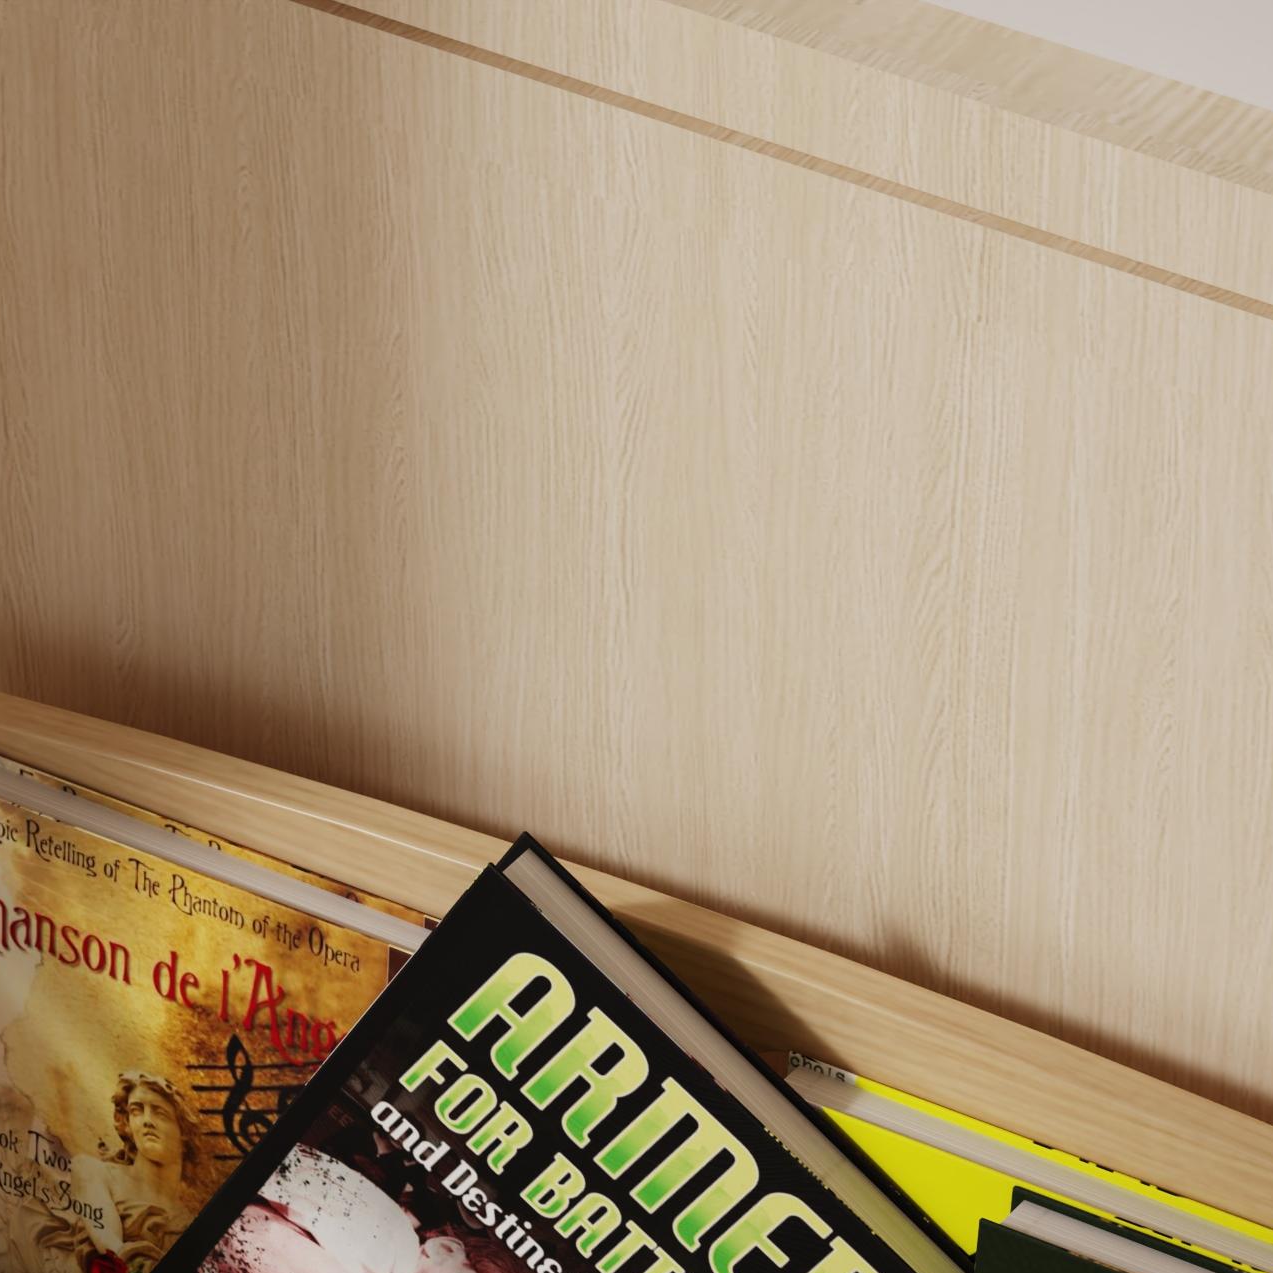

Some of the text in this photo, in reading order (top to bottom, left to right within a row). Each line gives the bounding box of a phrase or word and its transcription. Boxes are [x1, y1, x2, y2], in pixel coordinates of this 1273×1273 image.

[26, 819, 96, 879] Retelling
[104, 855, 121, 881] of
[129, 858, 160, 896] The
[169, 875, 244, 929] Phantom
[253, 915, 271, 939] of
[275, 918, 301, 951] the
[309, 926, 361, 973] Opera
[154, 952, 199, 1009] de
[220, 953, 346, 1067] l'Ang
[28, 1130, 72, 1173] Two:
[369, 1100, 453, 1174] and
[398, 1039, 534, 1174] FOR
[52, 1180, 104, 1230] Song
